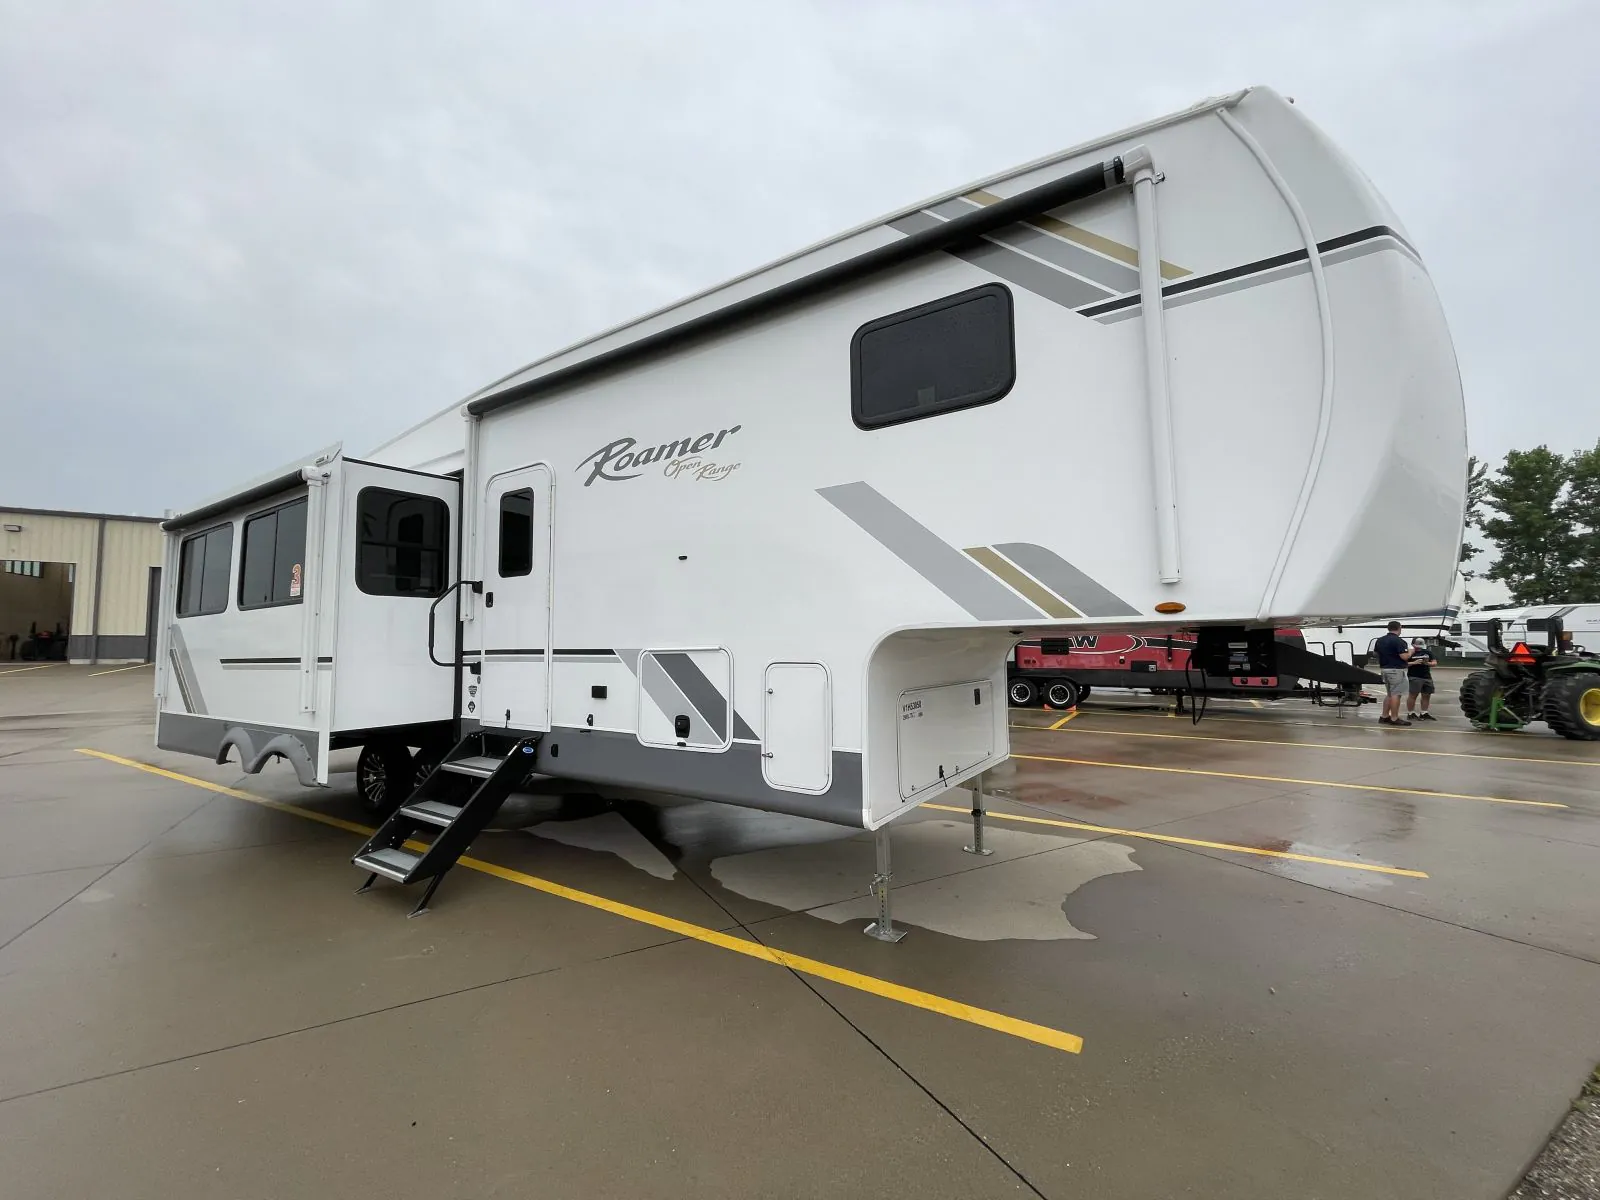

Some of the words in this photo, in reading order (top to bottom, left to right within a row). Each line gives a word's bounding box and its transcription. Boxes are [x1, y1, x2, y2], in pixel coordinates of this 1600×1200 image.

[575, 424, 742, 487] Roamer
[664, 456, 703, 480] Open
[692, 462, 742, 482] Range
[1068, 635, 1099, 649] W
